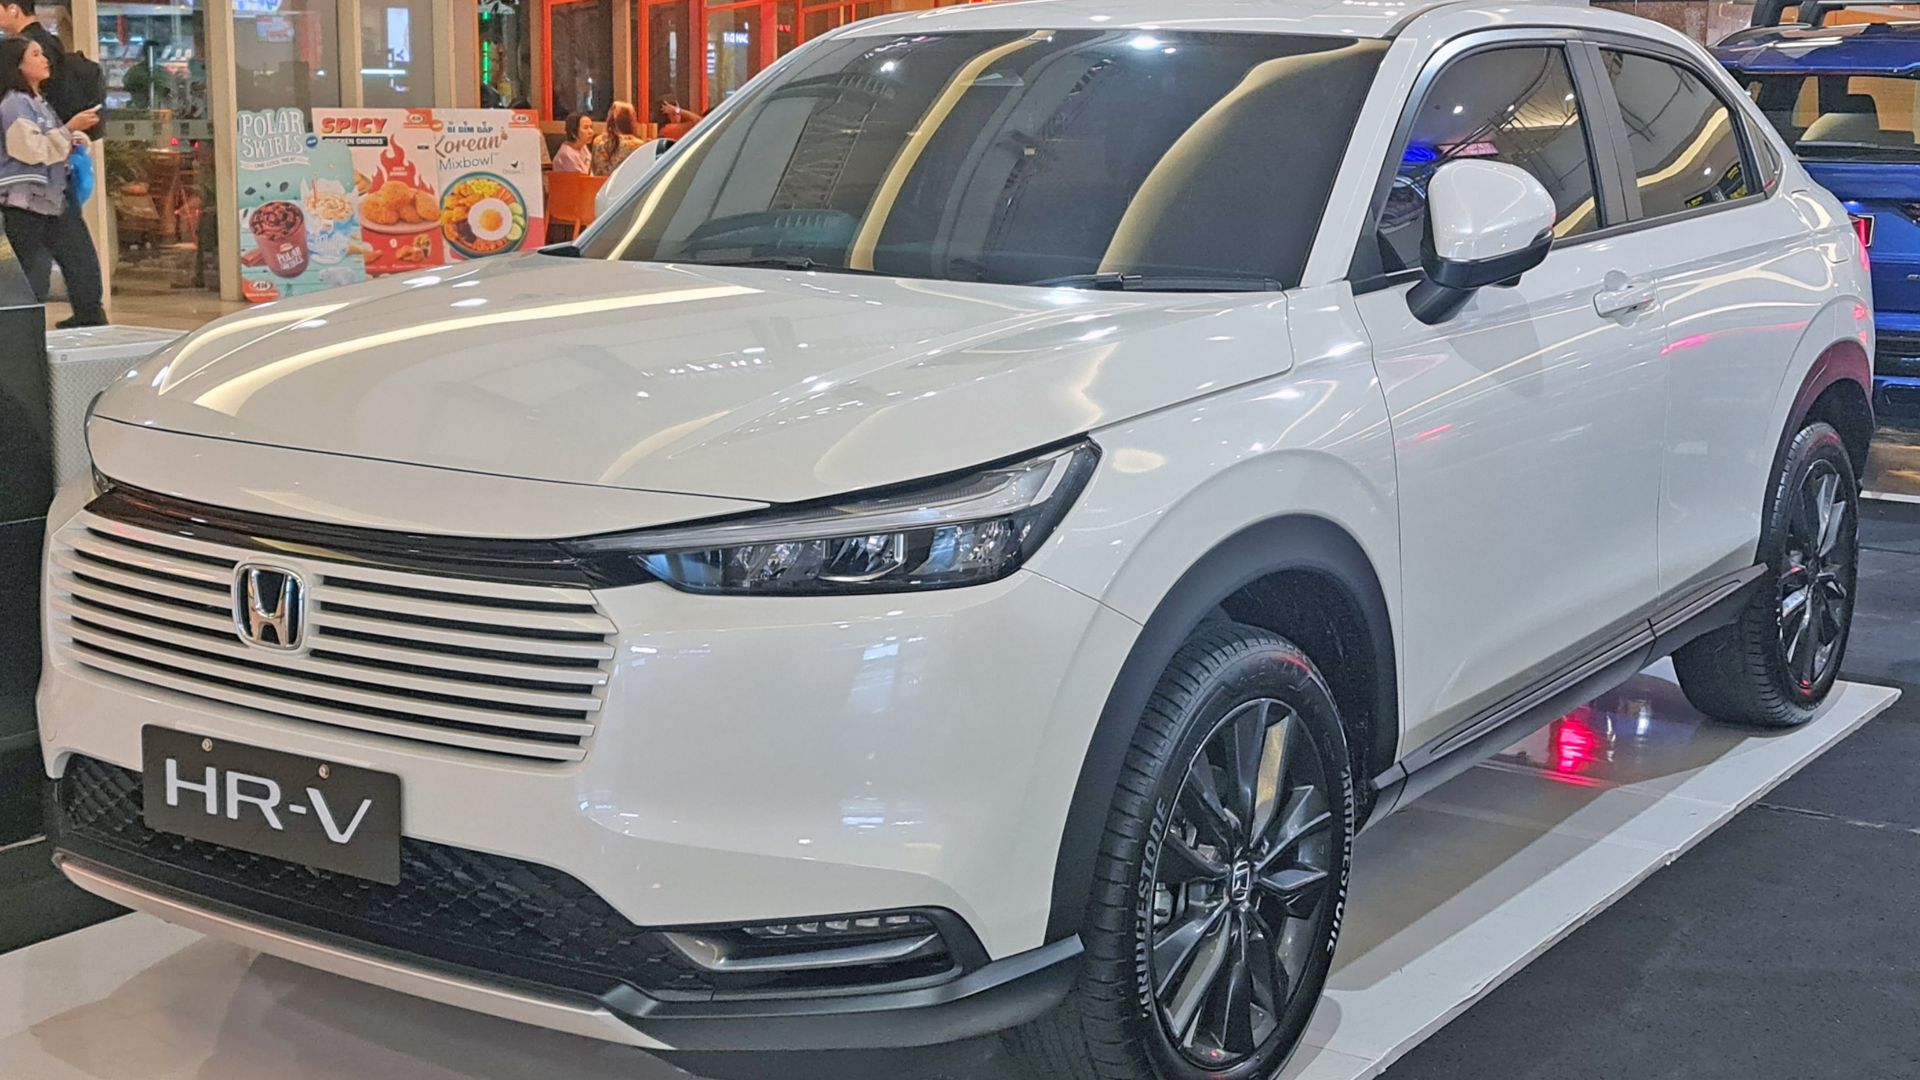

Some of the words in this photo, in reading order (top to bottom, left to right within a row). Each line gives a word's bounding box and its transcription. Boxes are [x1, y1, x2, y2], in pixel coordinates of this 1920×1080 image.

[240, 111, 302, 138] POLAR
[321, 117, 387, 134] SPICY
[242, 134, 304, 159] SWIRLS
[435, 134, 500, 159] Korean
[438, 153, 494, 171] Mixbowl
[165, 758, 372, 845] HR-V
